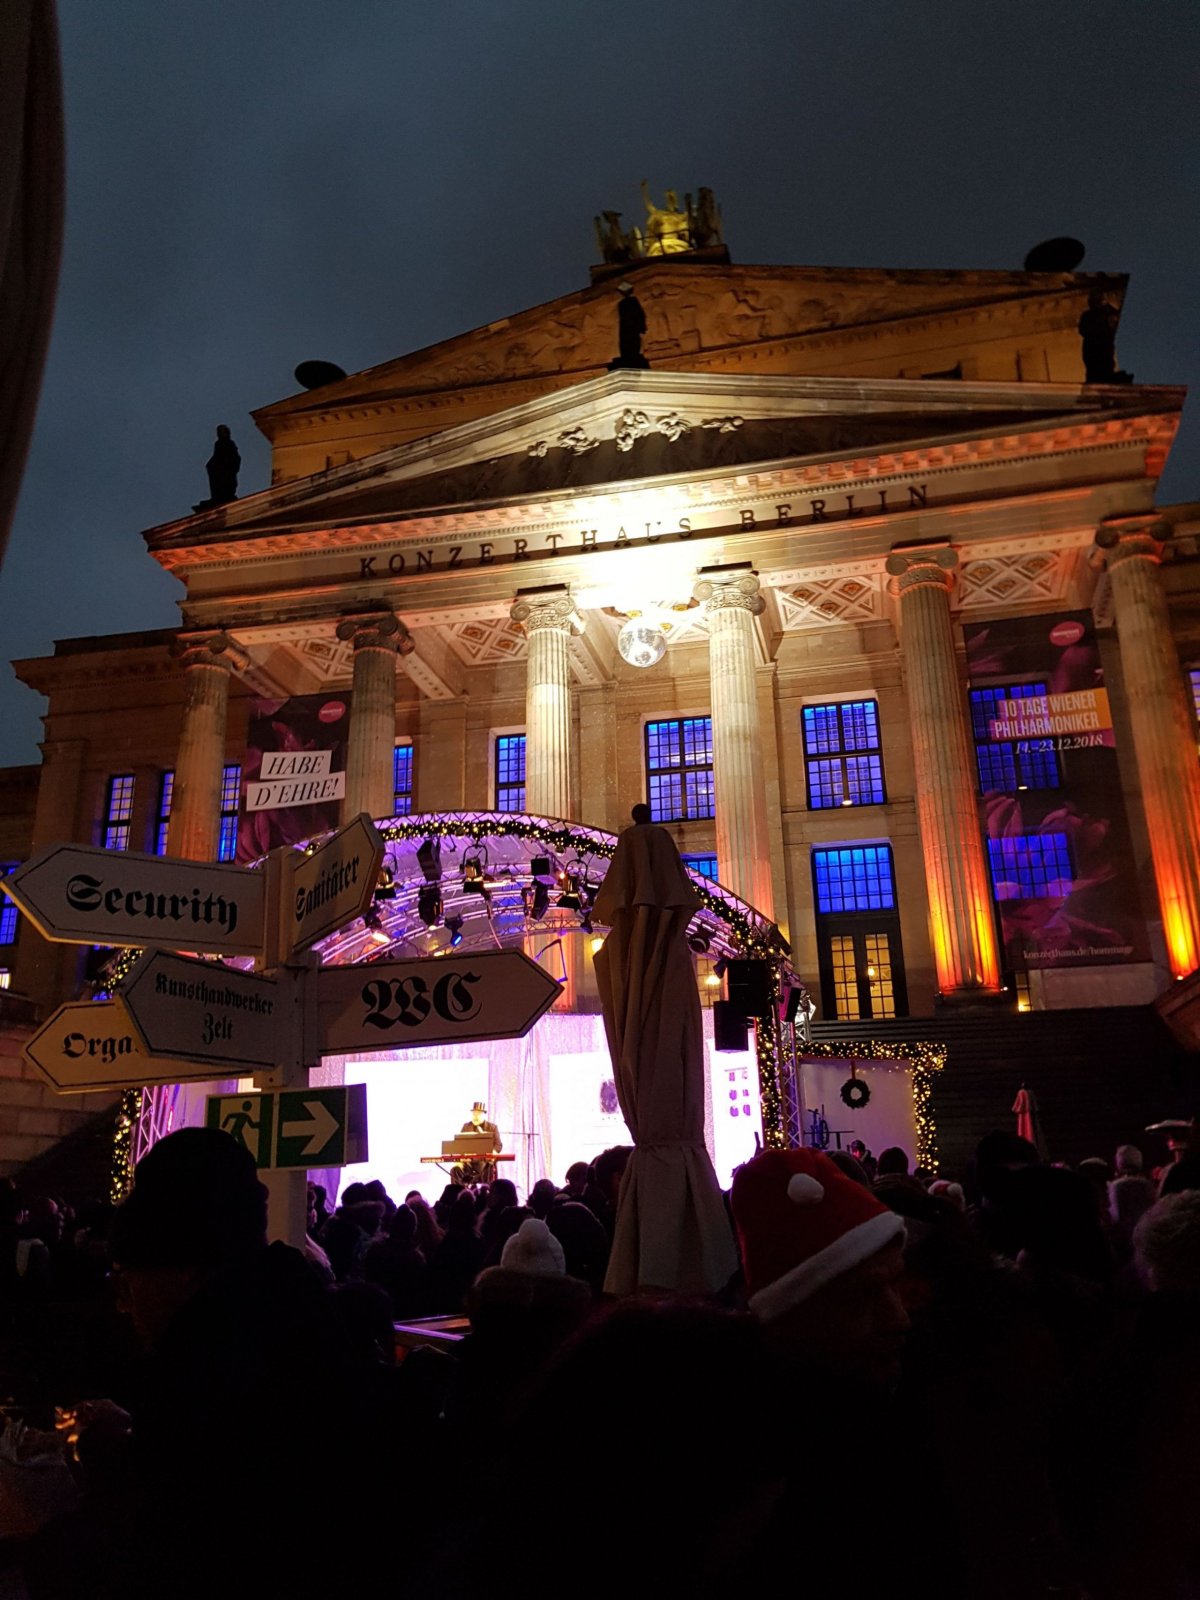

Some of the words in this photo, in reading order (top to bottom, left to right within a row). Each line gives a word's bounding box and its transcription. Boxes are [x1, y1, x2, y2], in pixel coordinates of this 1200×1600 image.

[359, 516, 692, 578] KONZERTHAUS
[740, 485, 929, 531] BERLIN
[995, 711, 1100, 739] PHILHARMONIKER
[1004, 699, 1017, 718] 10
[1020, 696, 1049, 716] TAGE
[1049, 690, 1097, 713] WIENER
[268, 755, 324, 775] HABE
[66, 874, 238, 936] Security
[295, 855, 361, 923] Sanitäter
[155, 972, 274, 1016] Kunsthandwerker
[361, 972, 483, 1030] WC
[202, 1012, 234, 1046] Zelt
